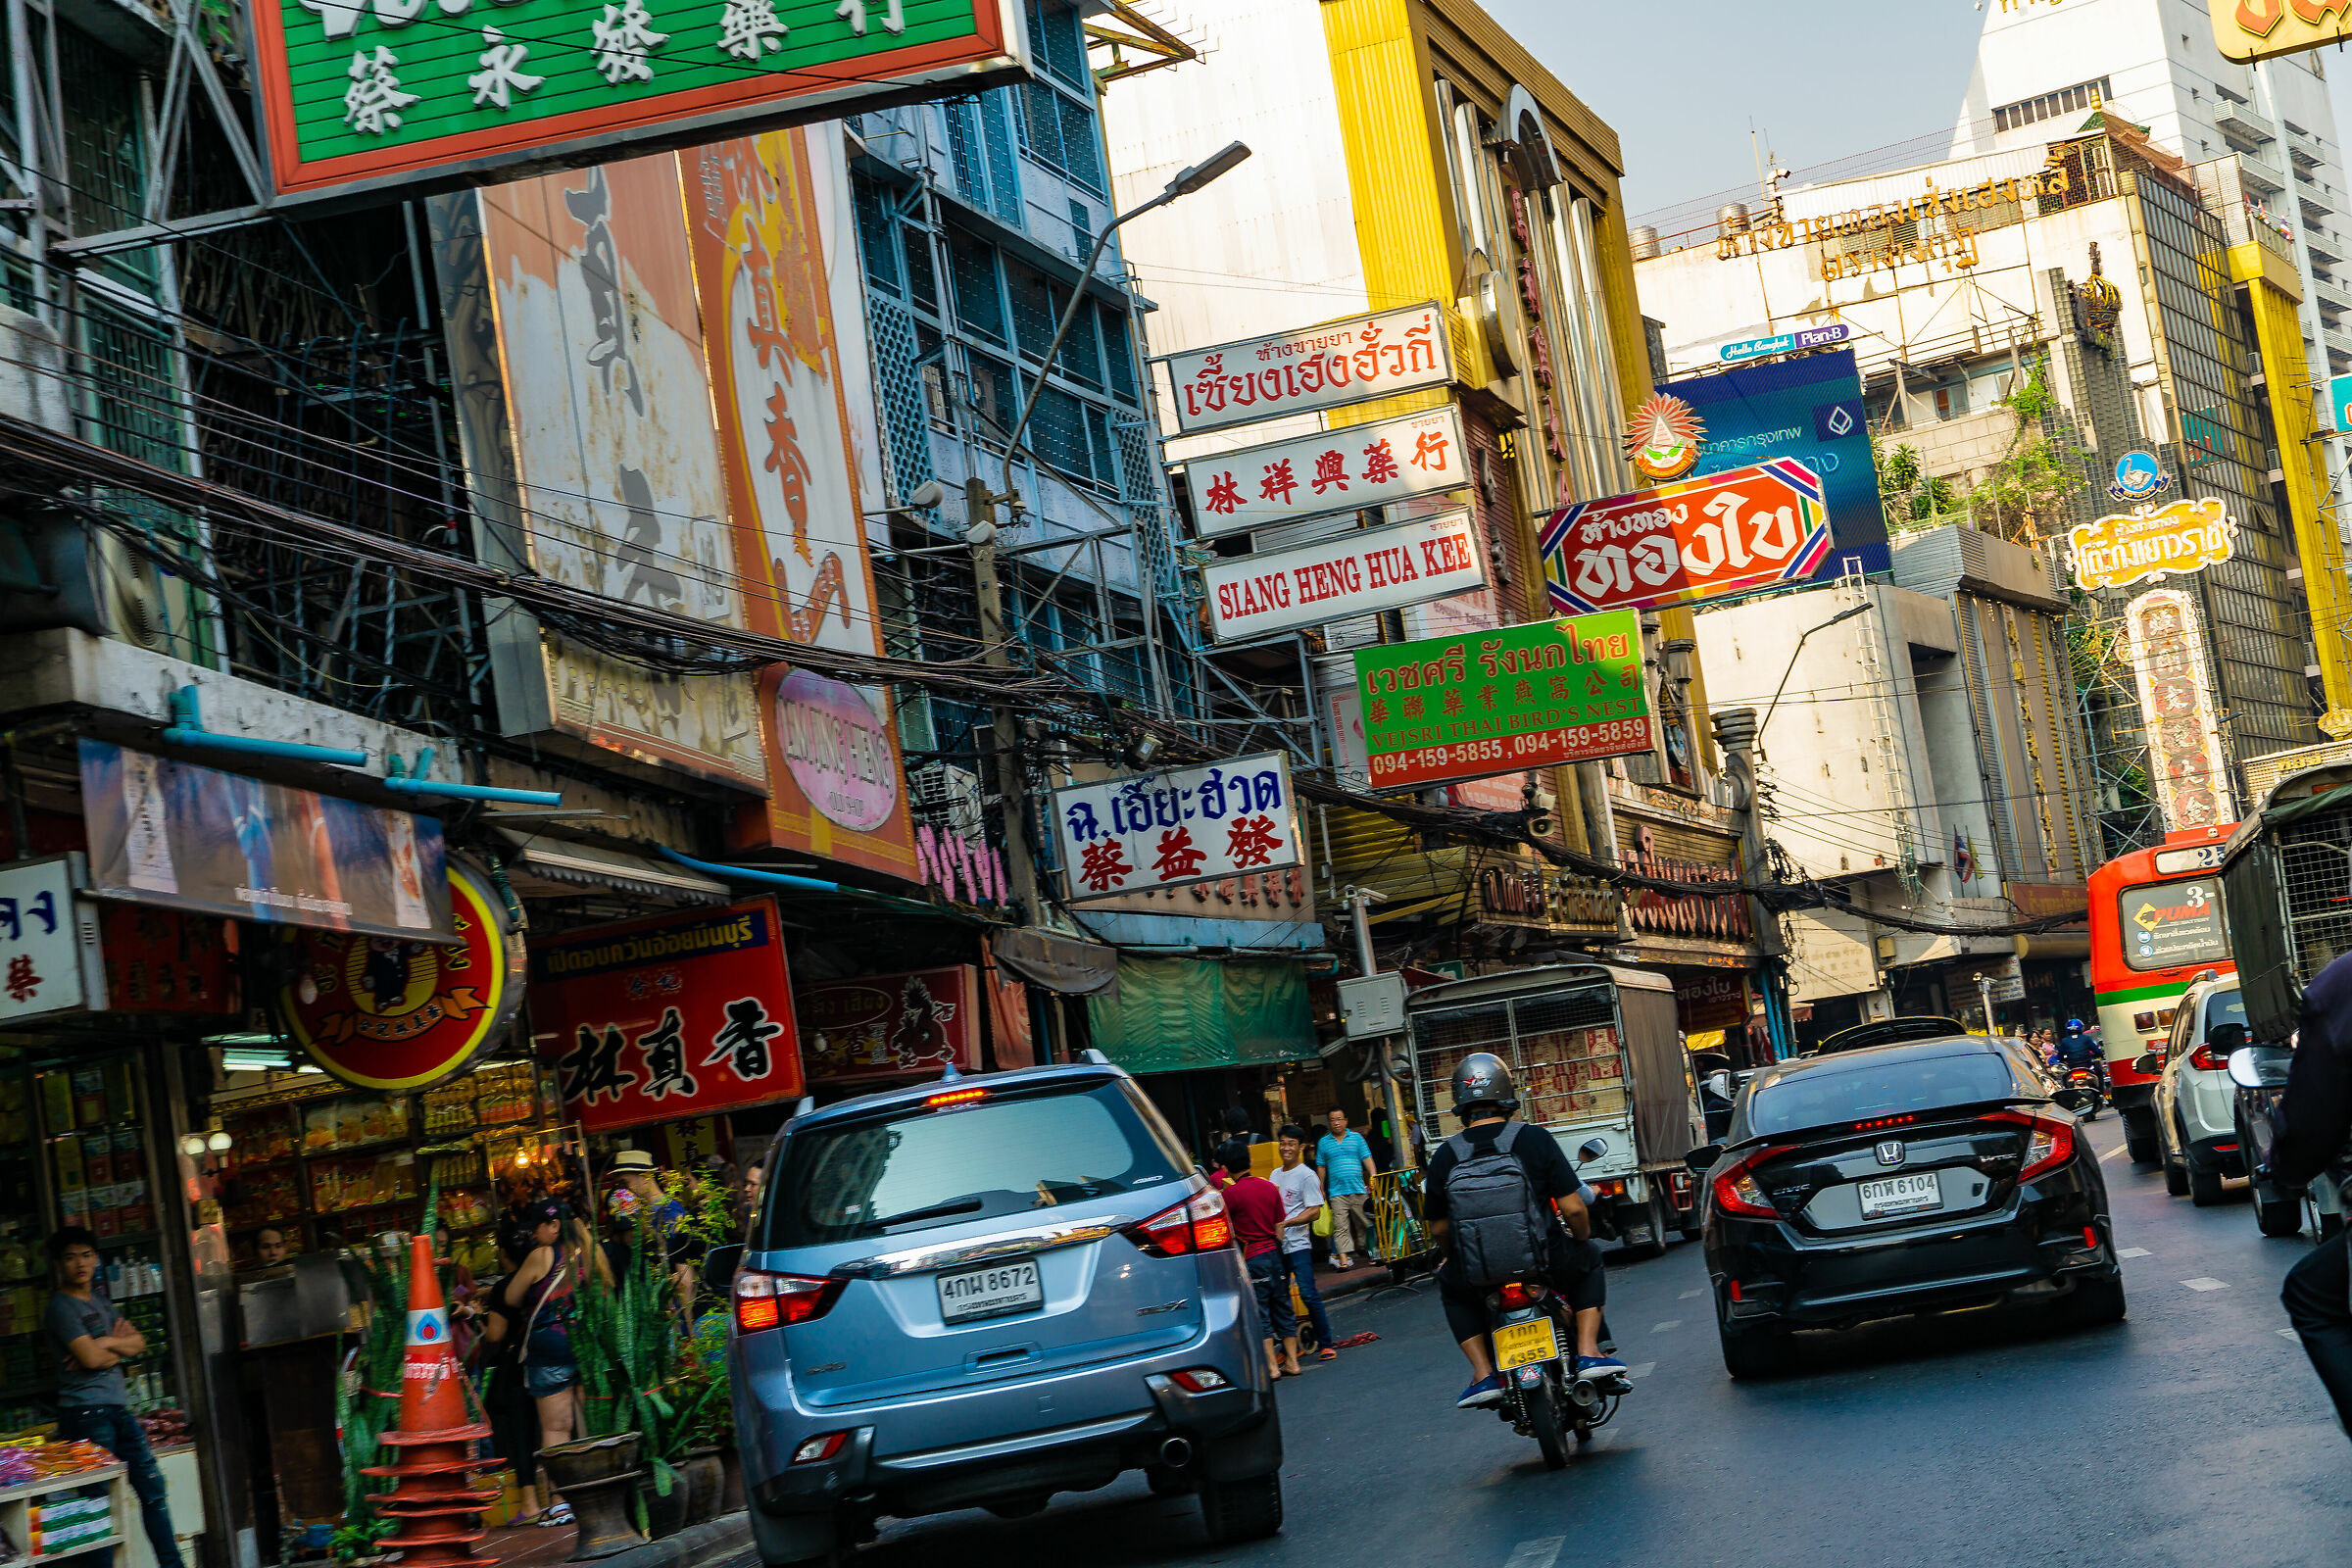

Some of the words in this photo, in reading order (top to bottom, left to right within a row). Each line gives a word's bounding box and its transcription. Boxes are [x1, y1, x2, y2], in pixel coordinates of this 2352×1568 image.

[1255, 332, 1352, 362] ห้างขายยา
[1698, 425, 1803, 456] นาคารกรุงเทพ
[1580, 502, 1689, 545] ห้างทอง
[1218, 572, 1291, 621] SIANG
[1294, 557, 1361, 605] HENG
[1364, 545, 1418, 590] HUA
[1420, 533, 1472, 577] KEE
[1366, 643, 1467, 695] เวชศรี
[1478, 623, 1630, 678] รังนกไทย
[1372, 724, 1442, 750] VEJSRI
[1450, 716, 1501, 739] THAI
[1509, 706, 1580, 730] BIRD'S
[1586, 697, 1642, 719] NEST
[1514, 718, 1645, 755] 094-159-5859
[1079, 814, 1284, 892] 蔡益發
[2153, 902, 2212, 922] PUMA
[562, 996, 783, 1107] 林真香
[1897, 1175, 1935, 1194] 6104
[988, 1266, 1037, 1291] 8672
[1507, 1347, 1546, 1365] 4355
